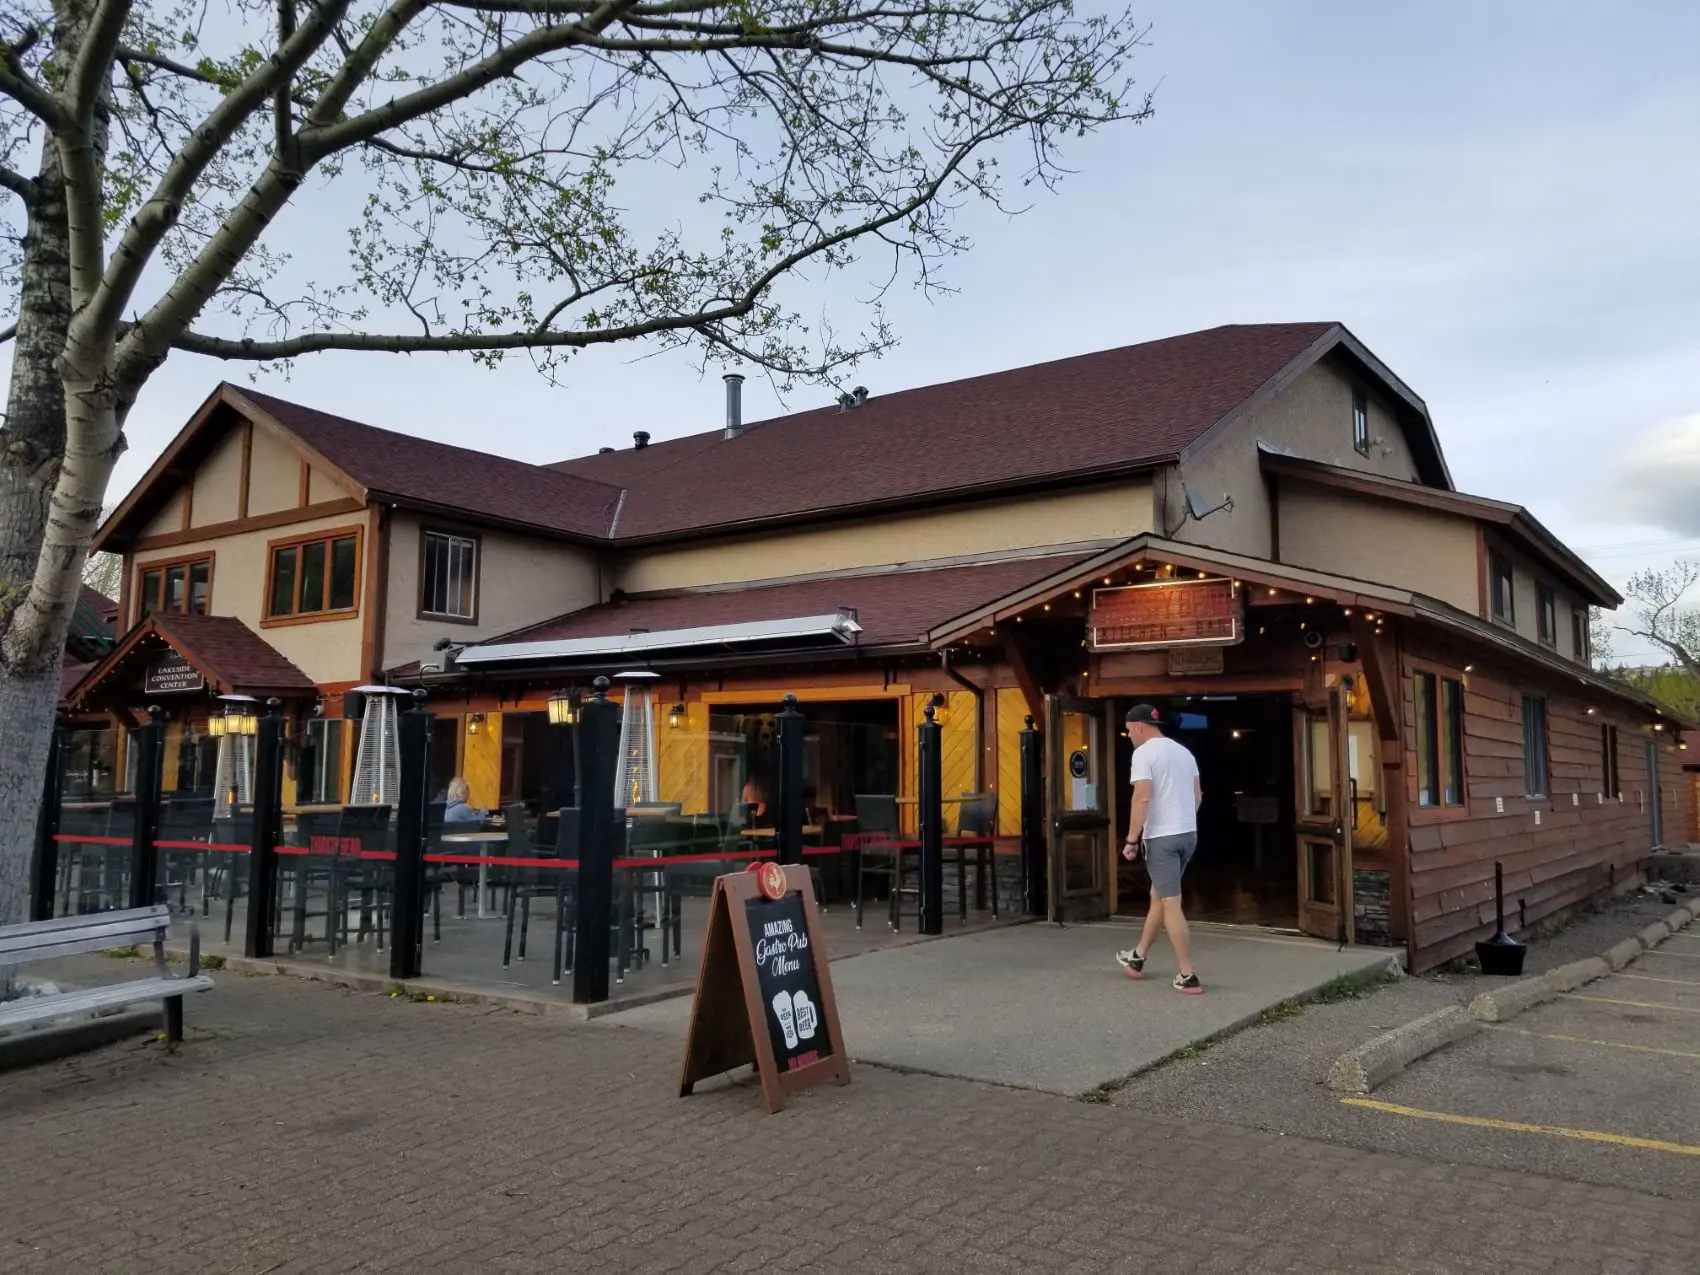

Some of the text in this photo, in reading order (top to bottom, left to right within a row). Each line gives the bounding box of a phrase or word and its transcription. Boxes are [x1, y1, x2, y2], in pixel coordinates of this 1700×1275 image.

[158, 665, 191, 674] LAKESIDE
[151, 672, 198, 682] CONVENTION
[160, 681, 188, 689] CENTER
[764, 919, 793, 938] AMAZING
[756, 932, 808, 966] Gastro Pub
[771, 955, 800, 977] Menu
